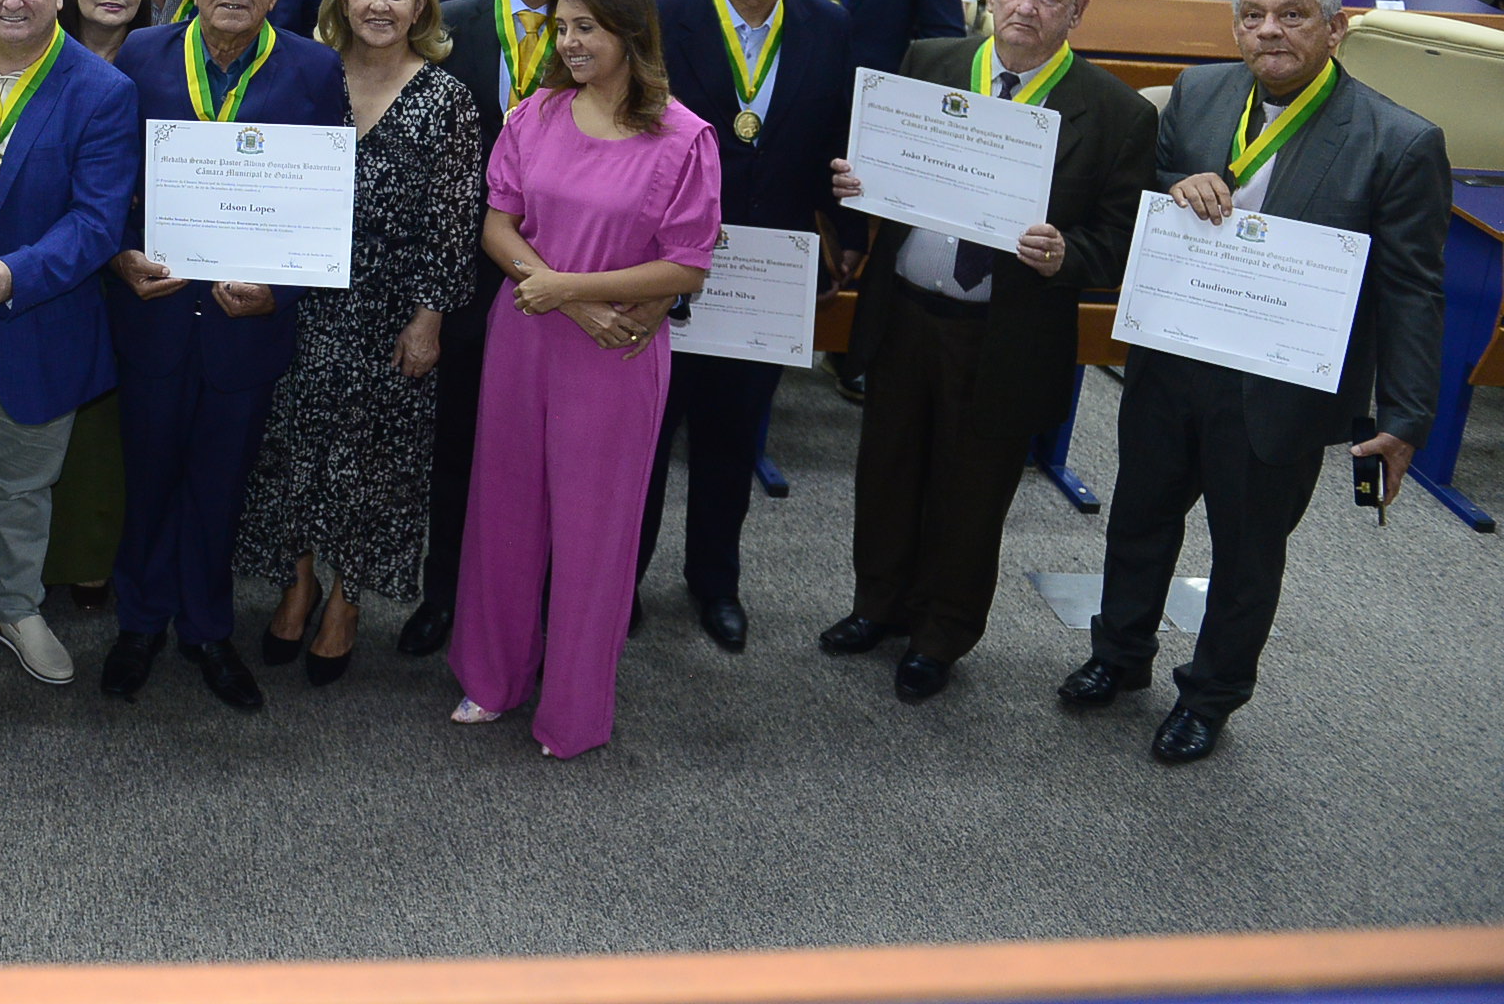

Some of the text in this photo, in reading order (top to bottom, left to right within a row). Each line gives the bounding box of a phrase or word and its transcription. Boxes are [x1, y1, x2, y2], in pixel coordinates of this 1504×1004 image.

[267, 161, 301, 170] Gonçalves
[303, 163, 341, 171] Boaventura
[901, 150, 921, 159] João
[923, 155, 956, 169] Ferreira
[971, 167, 995, 179] Costa
[196, 167, 224, 175] Câmara
[226, 169, 263, 178] Municipal
[220, 203, 276, 215] Edson Lopes
[707, 288, 756, 300] Rafael Silva
[1191, 279, 1244, 296] Claudionor
[1245, 291, 1288, 306] Sardinha
